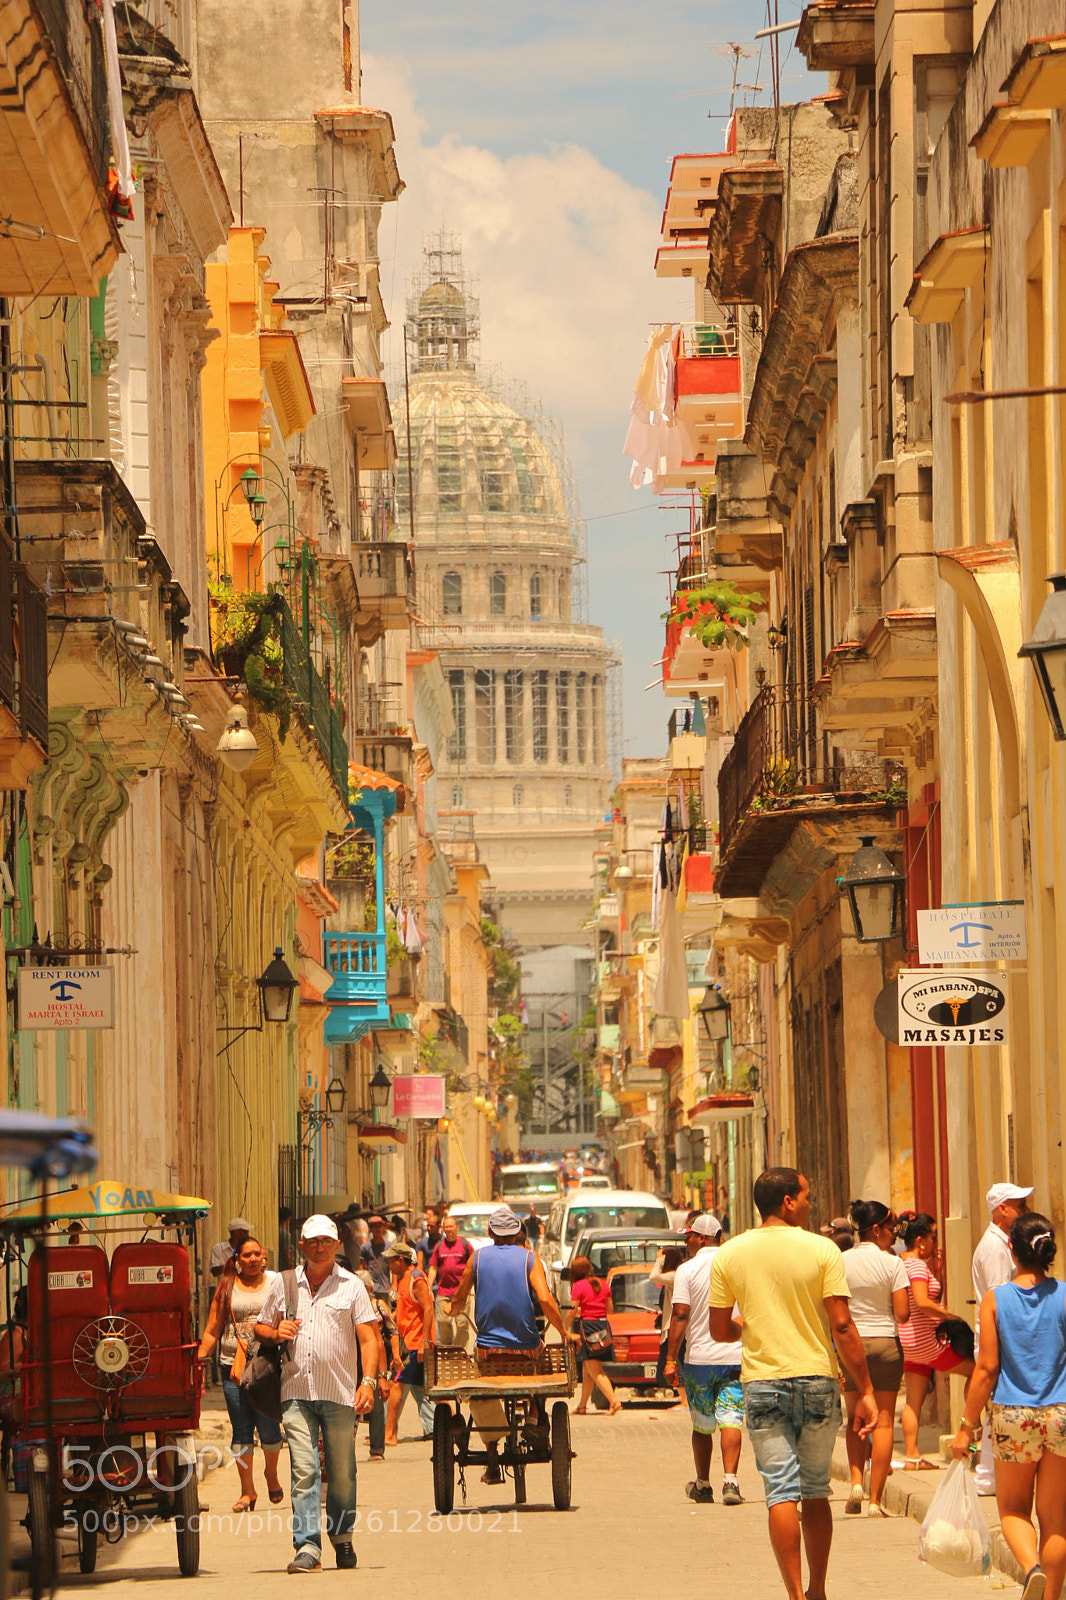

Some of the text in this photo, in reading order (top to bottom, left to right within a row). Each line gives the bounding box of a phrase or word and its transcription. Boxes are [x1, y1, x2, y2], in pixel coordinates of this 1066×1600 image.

[929, 910, 1014, 922] HOSPEDAJE
[926, 948, 1020, 961] MARIANA & KATY
[32, 970, 100, 980] RENT ROOM
[912, 983, 1000, 999] MI HABANA SPA
[47, 1003, 86, 1011] HOSTAL
[28, 1010, 106, 1019] MARTA E ISRAEL
[54, 1018, 73, 1026] Apto
[903, 1028, 1004, 1045] MASAJES
